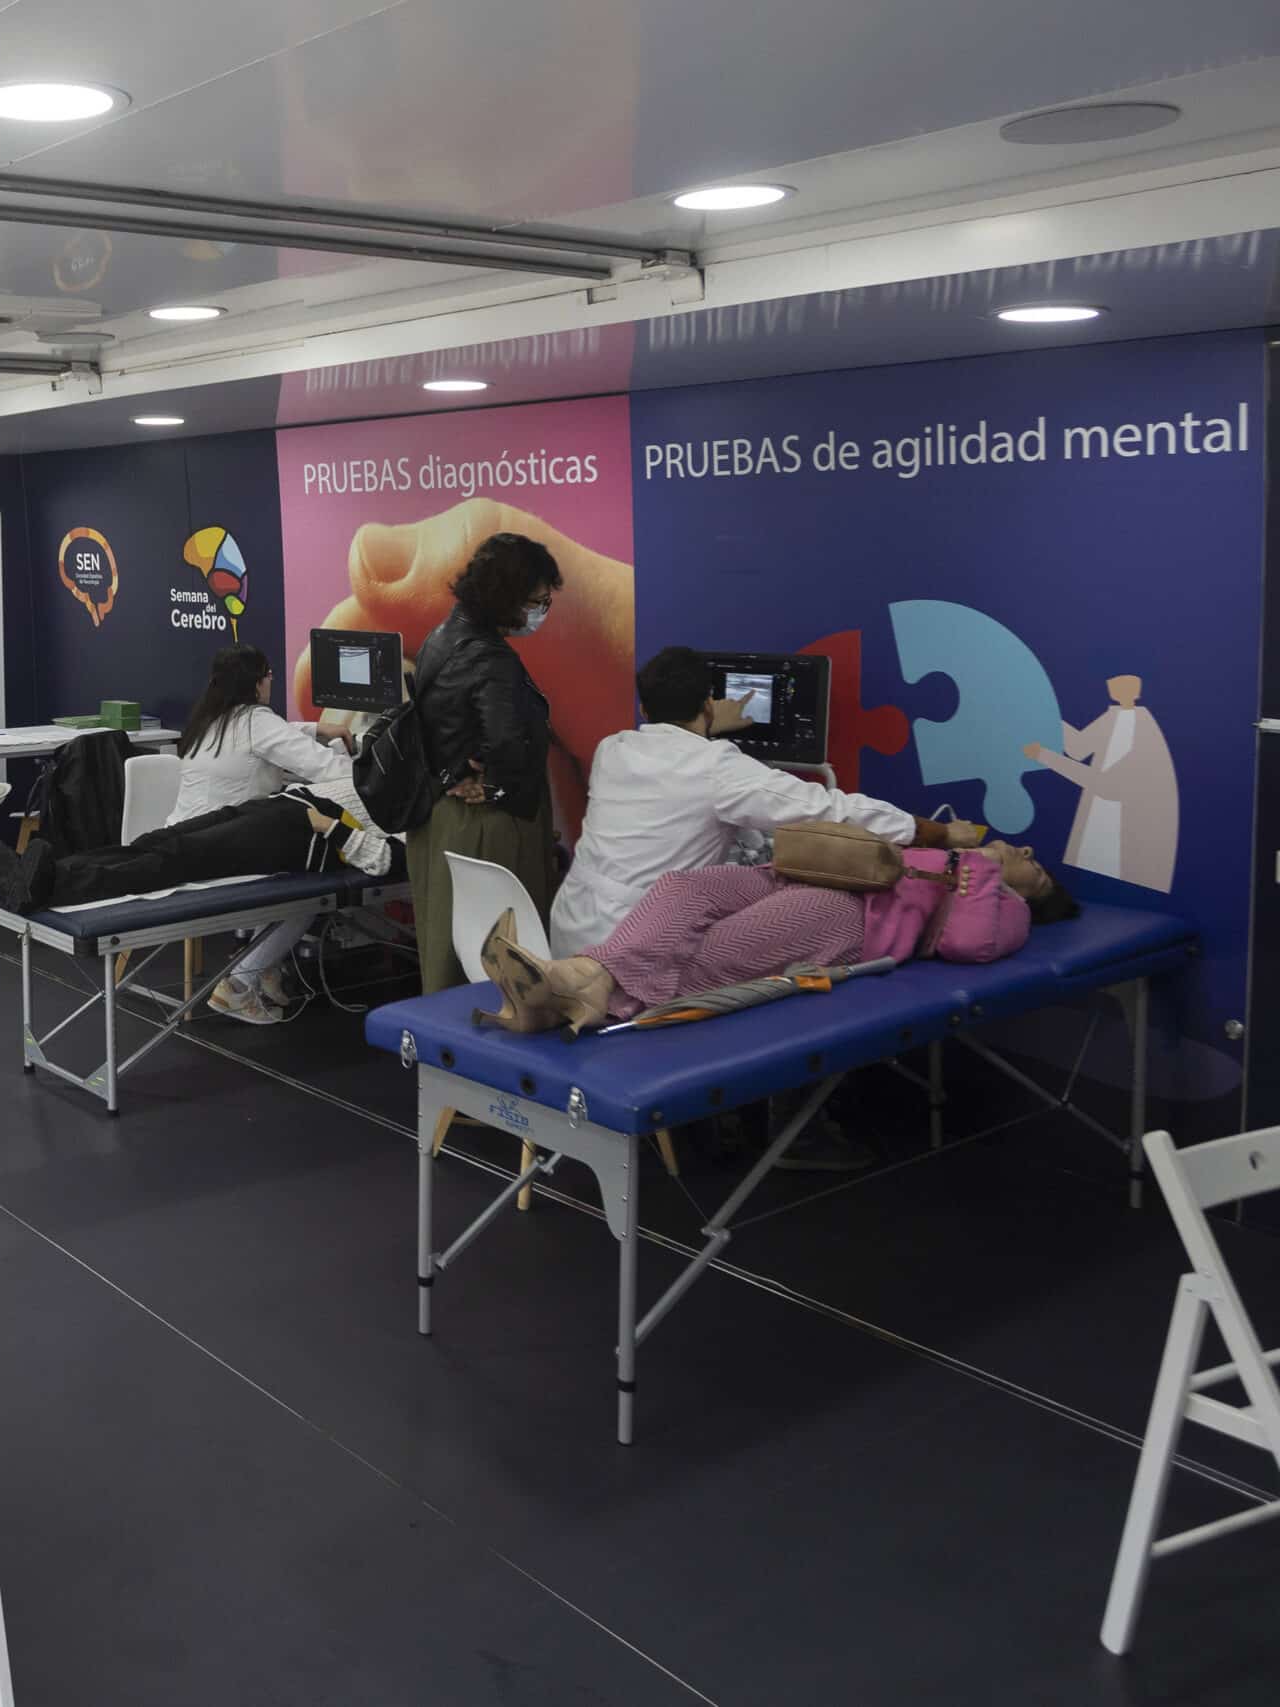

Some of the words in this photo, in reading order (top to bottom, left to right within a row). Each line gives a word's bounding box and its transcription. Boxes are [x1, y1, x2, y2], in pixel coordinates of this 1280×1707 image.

[644, 434, 802, 479] PRUEBAS
[812, 430, 860, 471] de
[871, 416, 1047, 479] agilidad
[1063, 401, 1249, 459] mental
[303, 456, 412, 495] PRUEBAS
[419, 449, 599, 498] diagnósticas
[76, 553, 100, 571] SEN
[170, 588, 209, 603] Semana
[205, 603, 217, 613] del
[171, 608, 227, 631] Cerebro
